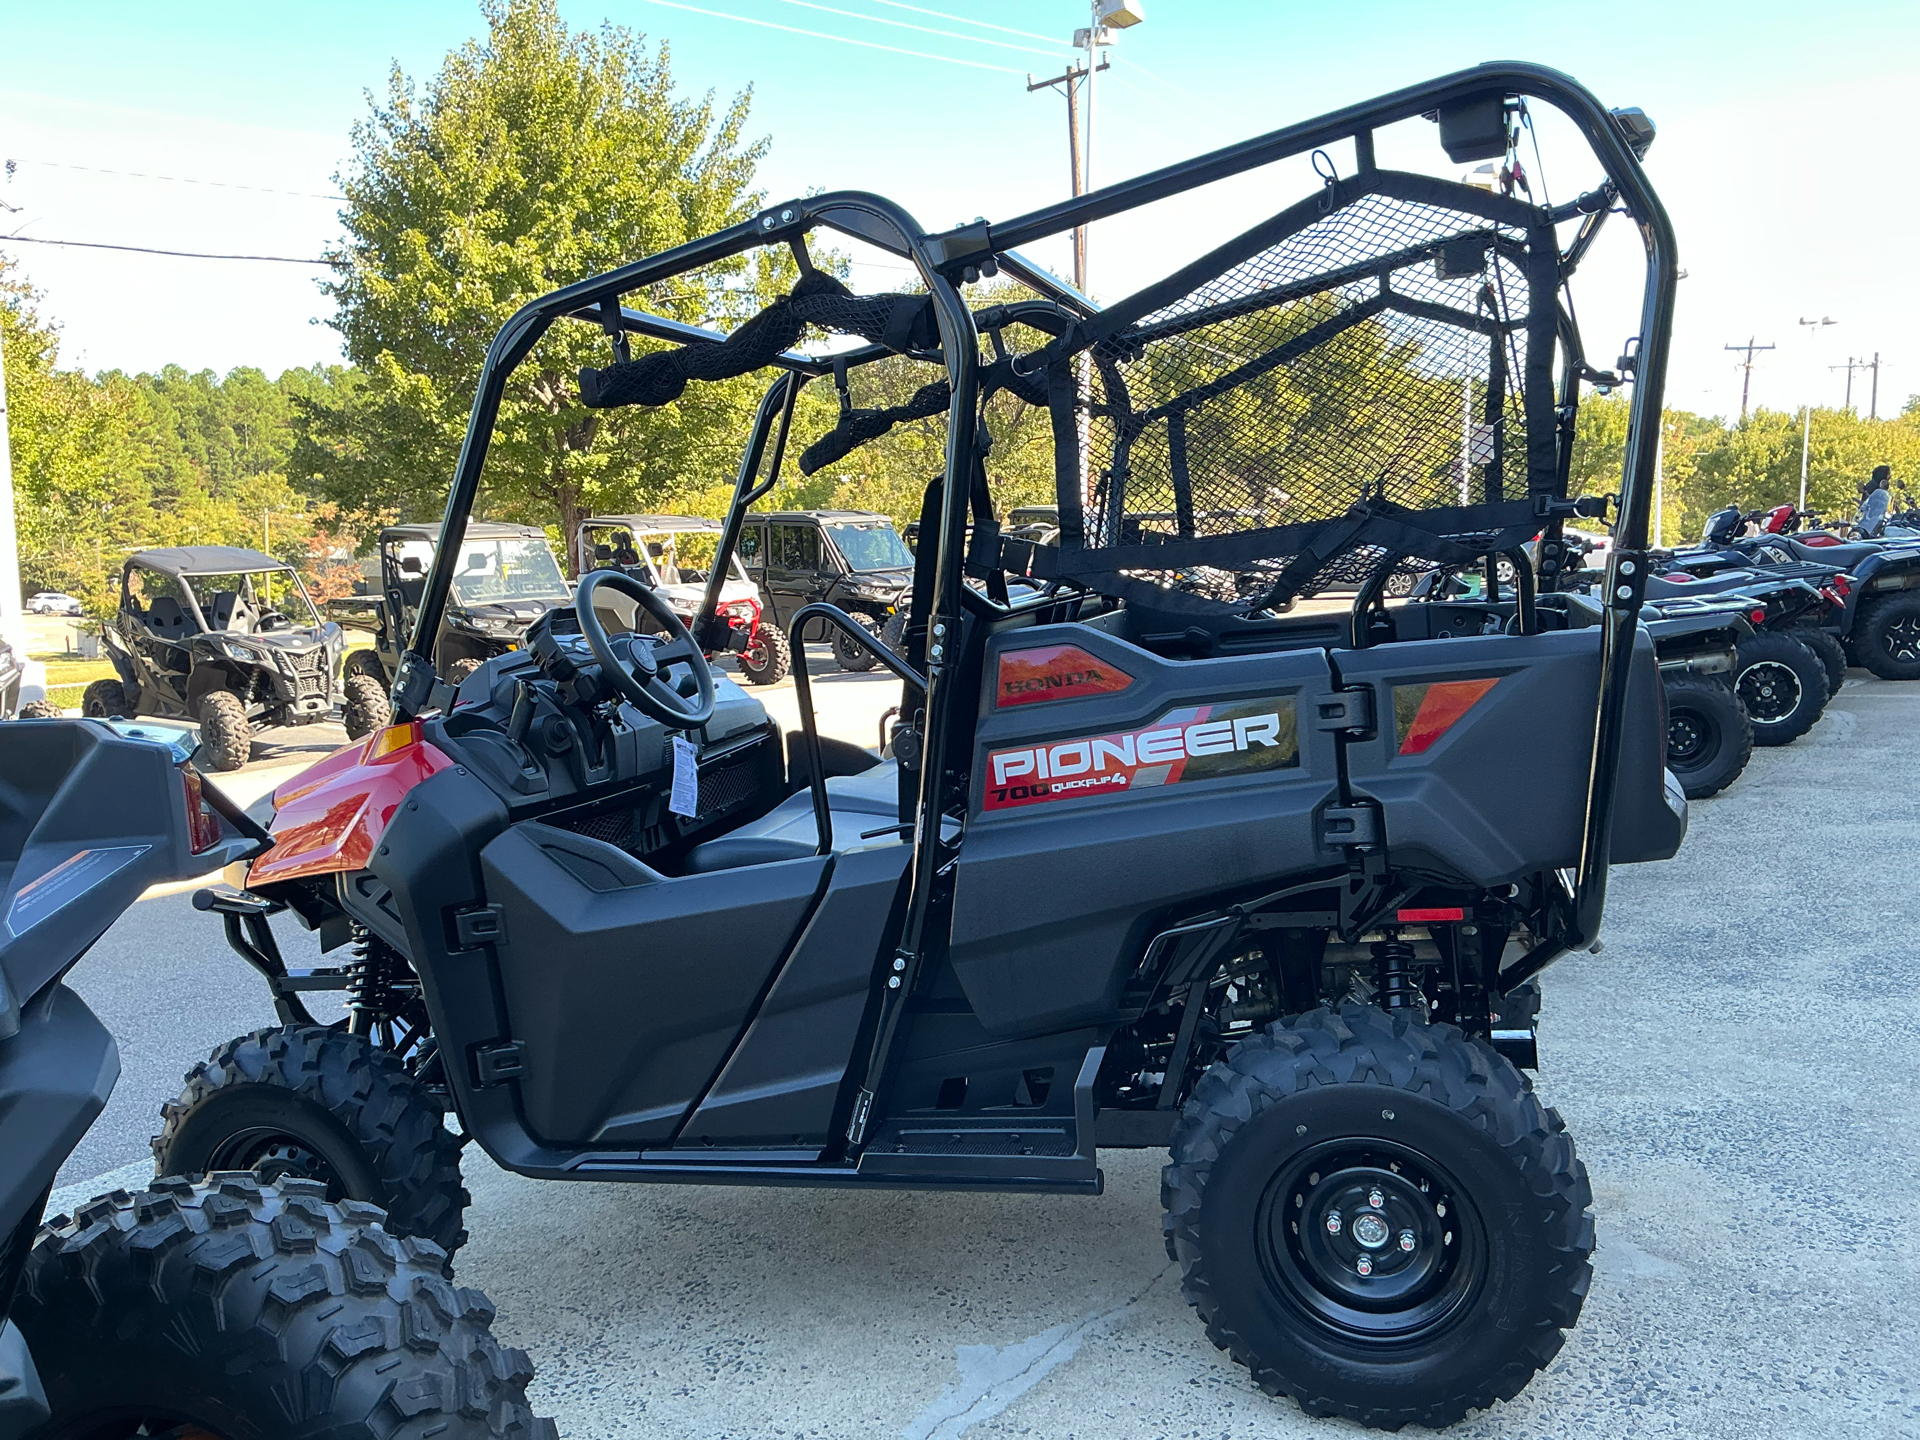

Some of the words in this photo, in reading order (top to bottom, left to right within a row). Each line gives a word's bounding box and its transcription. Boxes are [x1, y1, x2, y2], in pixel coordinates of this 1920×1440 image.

[1004, 669, 1104, 695] HONDA
[993, 713, 1280, 785] PIONEER
[990, 783, 1049, 802] 700
